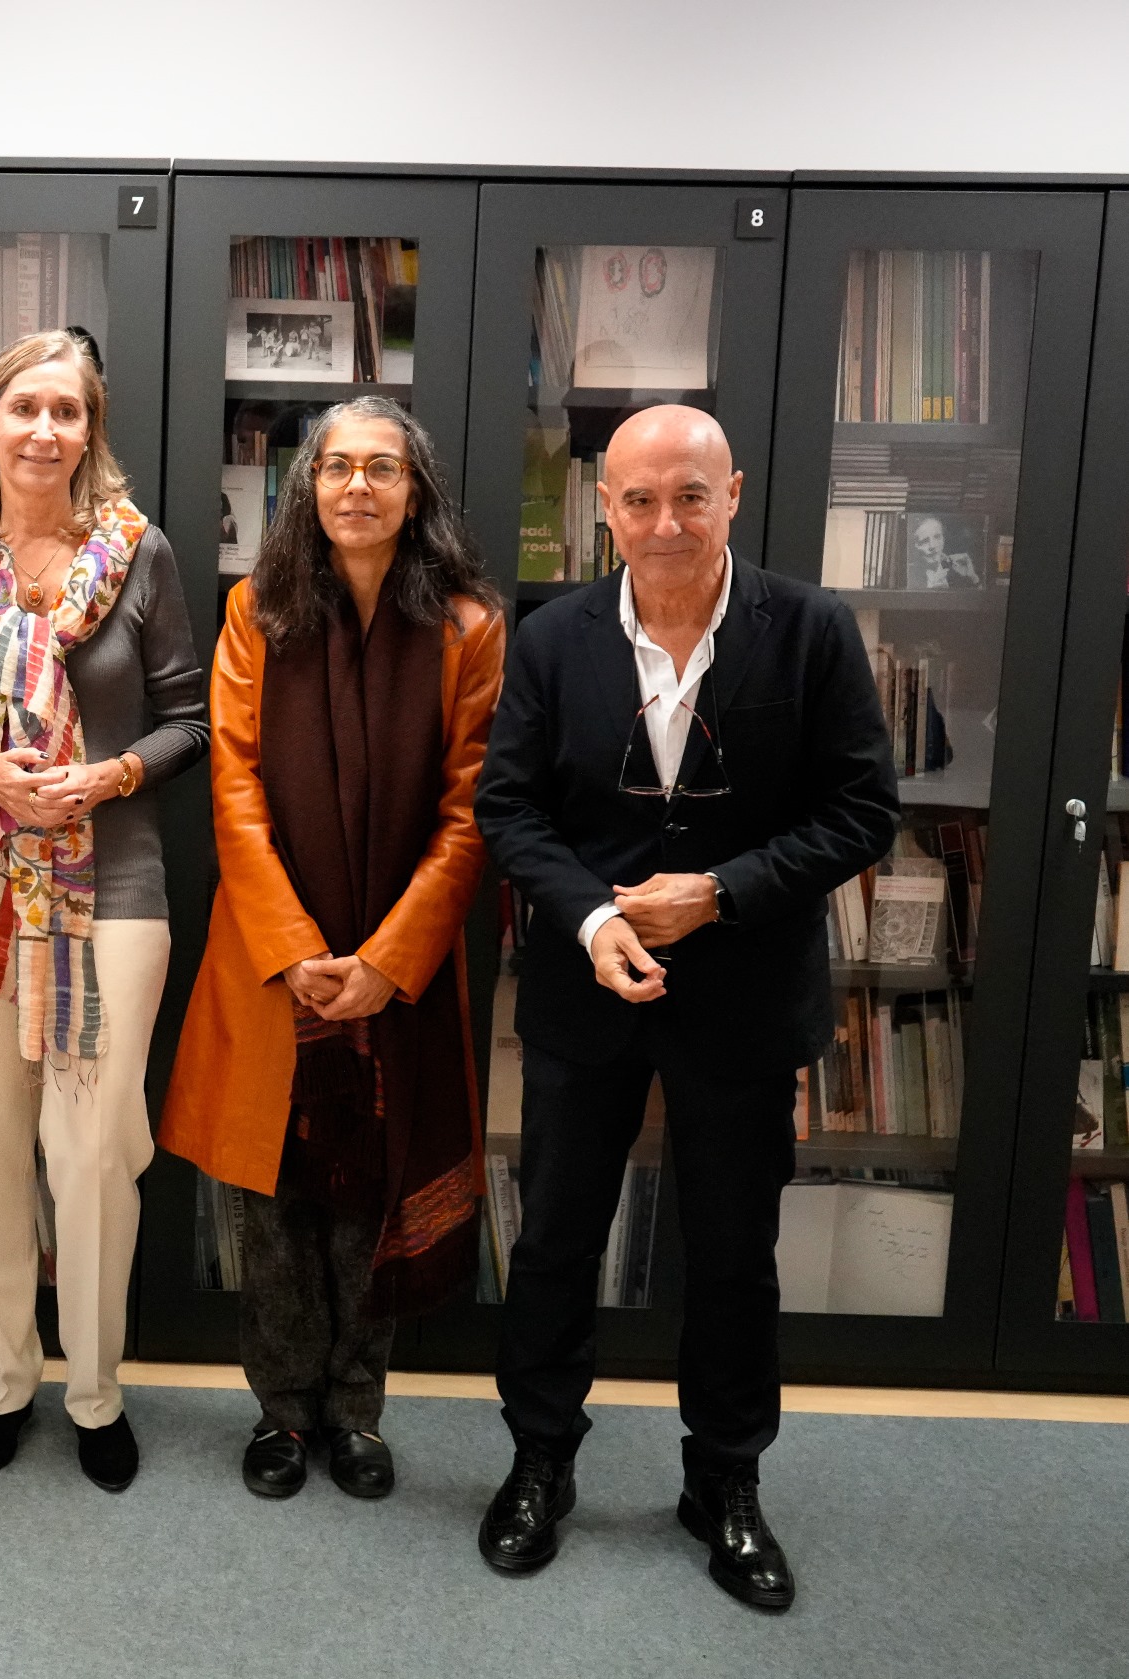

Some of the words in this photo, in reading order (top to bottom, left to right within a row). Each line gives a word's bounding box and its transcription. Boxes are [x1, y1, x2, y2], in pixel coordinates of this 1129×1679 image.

[131, 196, 144, 215] 7
[751, 209, 764, 226] 8
[522, 541, 562, 553] roots
